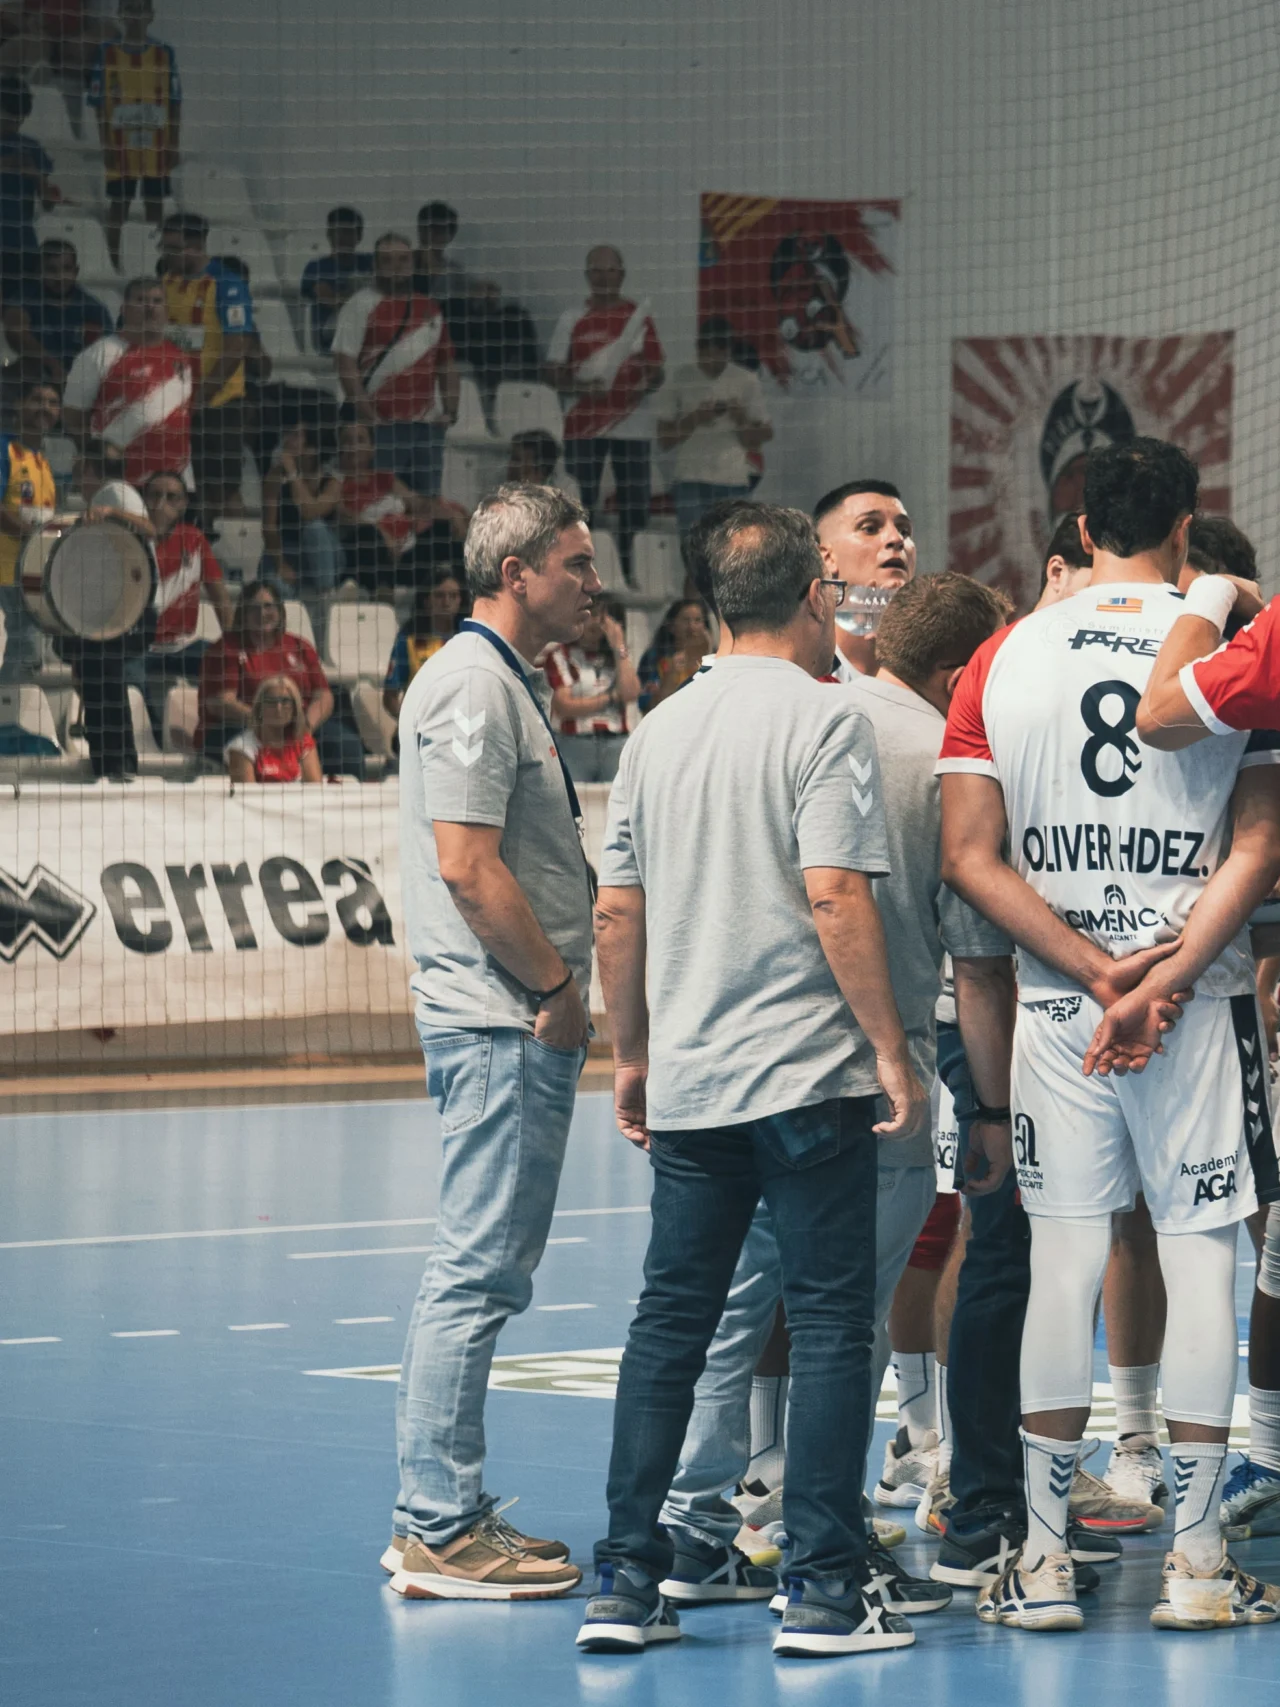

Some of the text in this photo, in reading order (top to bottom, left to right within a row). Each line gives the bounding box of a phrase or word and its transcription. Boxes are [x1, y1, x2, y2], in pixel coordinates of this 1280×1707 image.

[1080, 679, 1143, 798] 8
[1022, 823, 1209, 878] OLIVER HDEZ.
[1180, 1150, 1239, 1177] Academi
